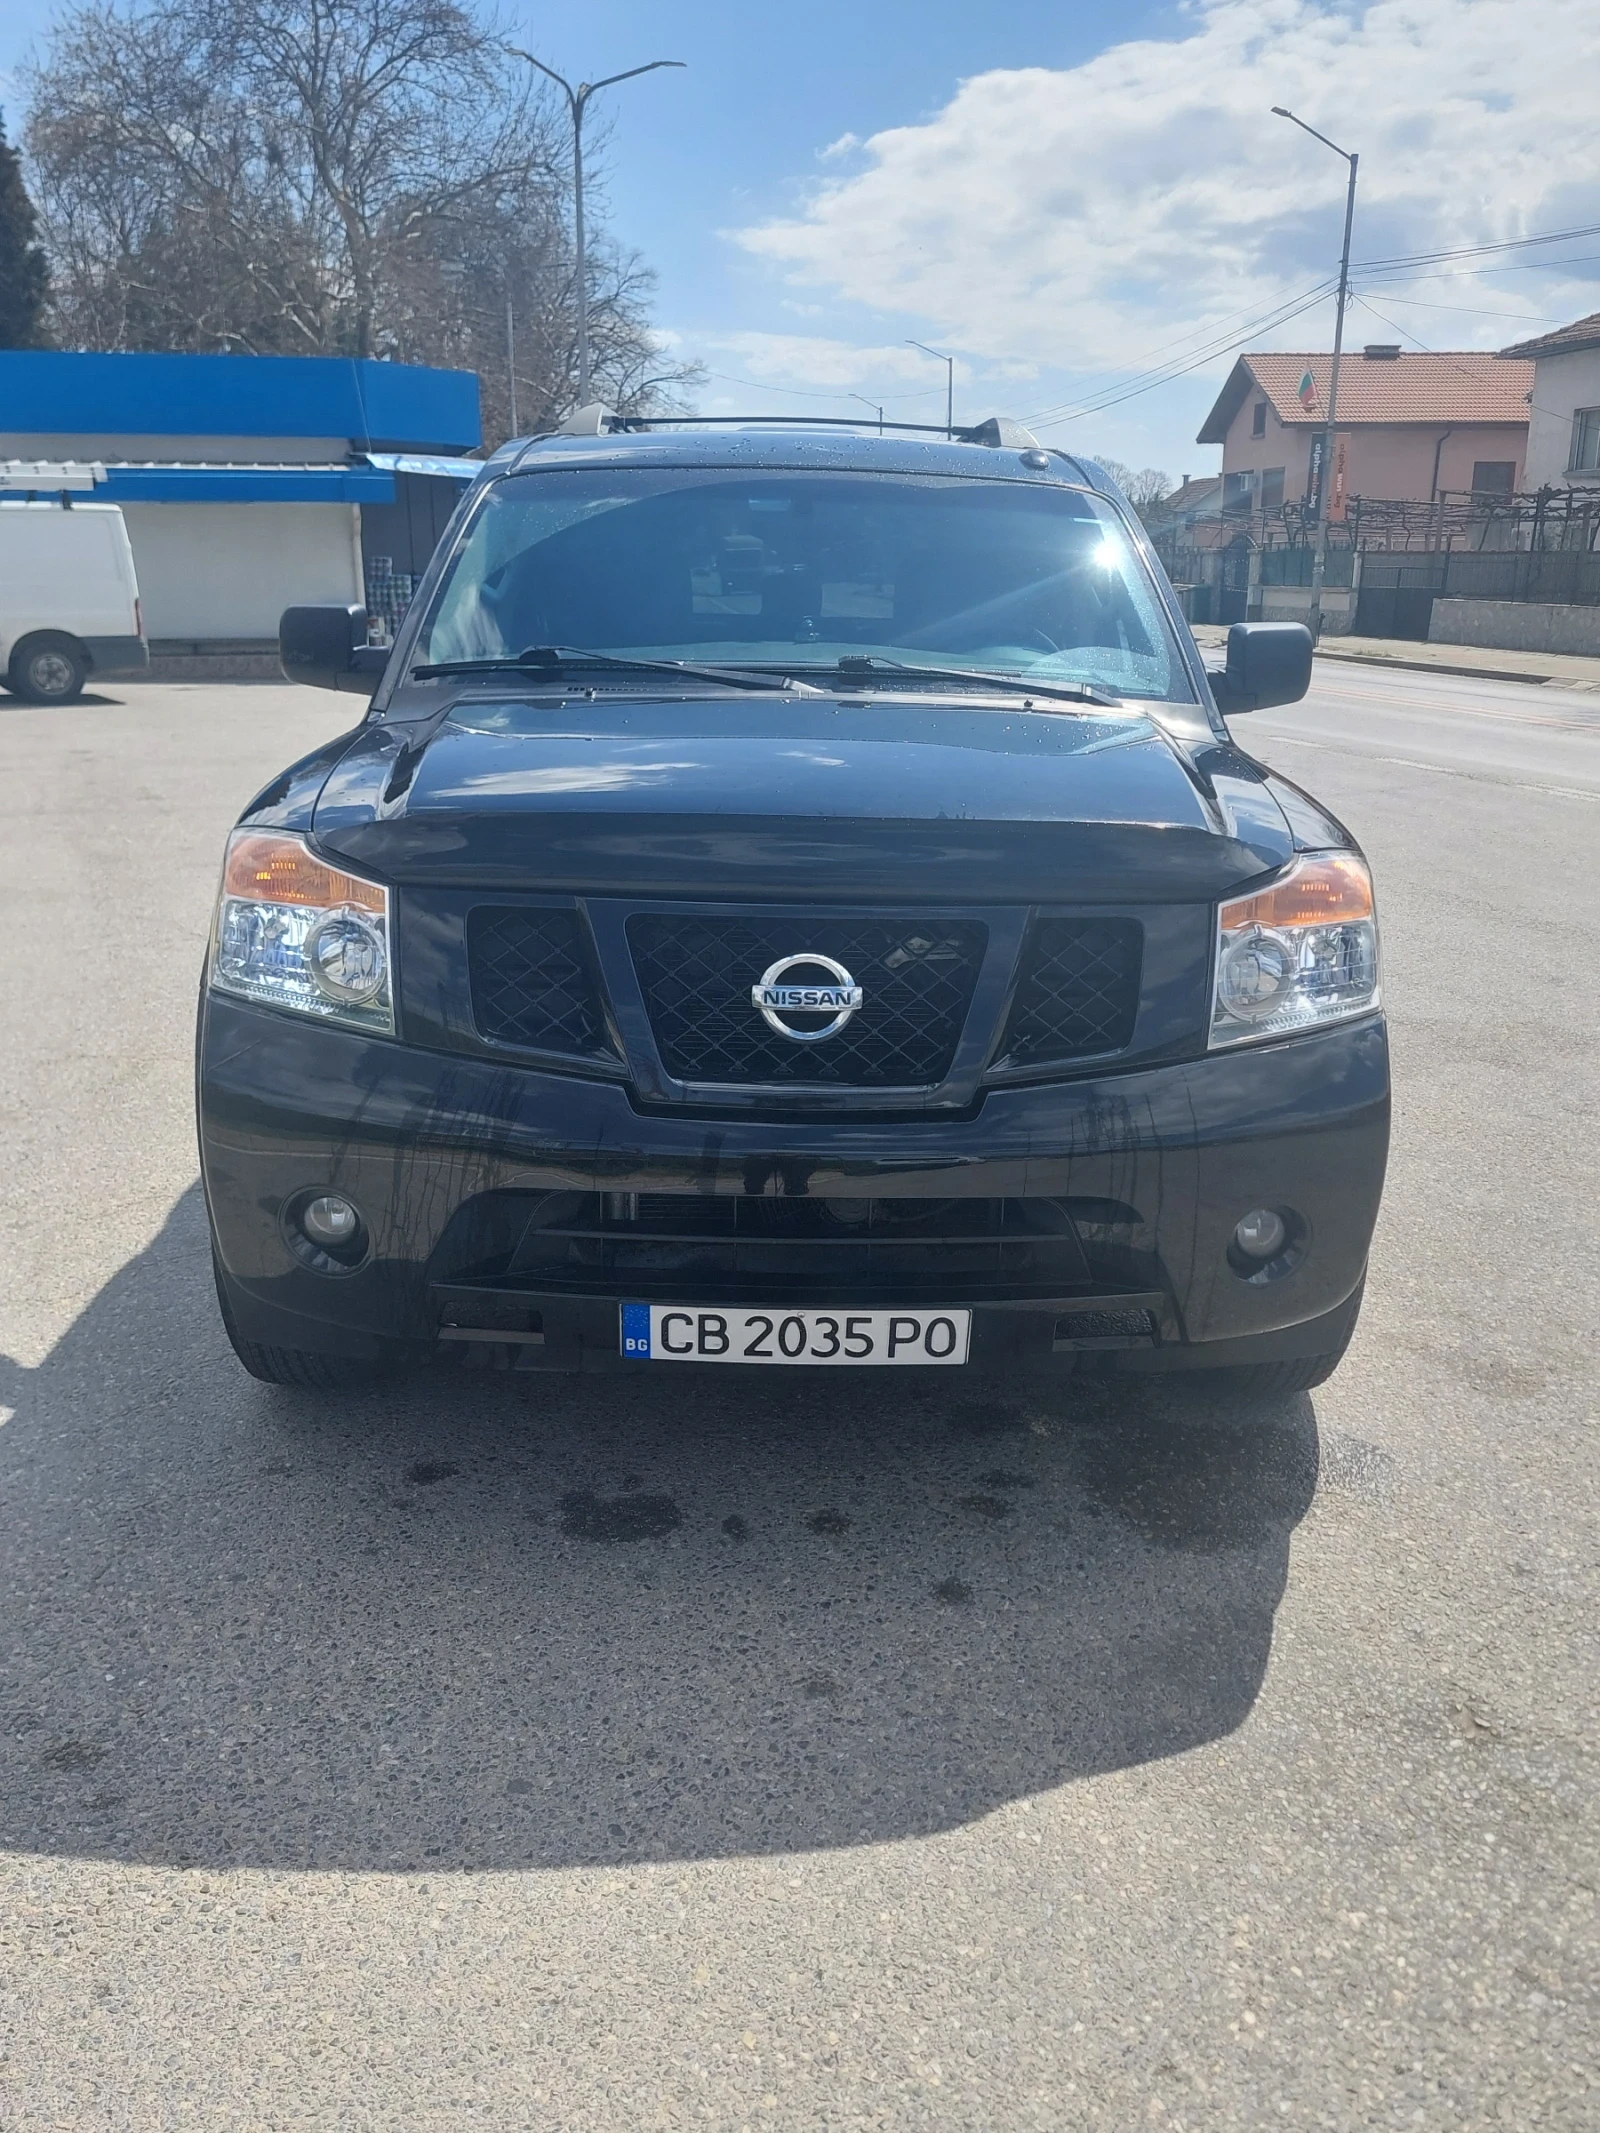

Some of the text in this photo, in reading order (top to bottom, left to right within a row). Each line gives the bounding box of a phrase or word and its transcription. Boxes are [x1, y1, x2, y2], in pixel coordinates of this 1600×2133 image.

[1309, 443, 1322, 508] alphawin.bg
[763, 990, 852, 1006] NISSAN
[625, 1339, 648, 1351] BG
[743, 1315, 874, 1358] 2035
